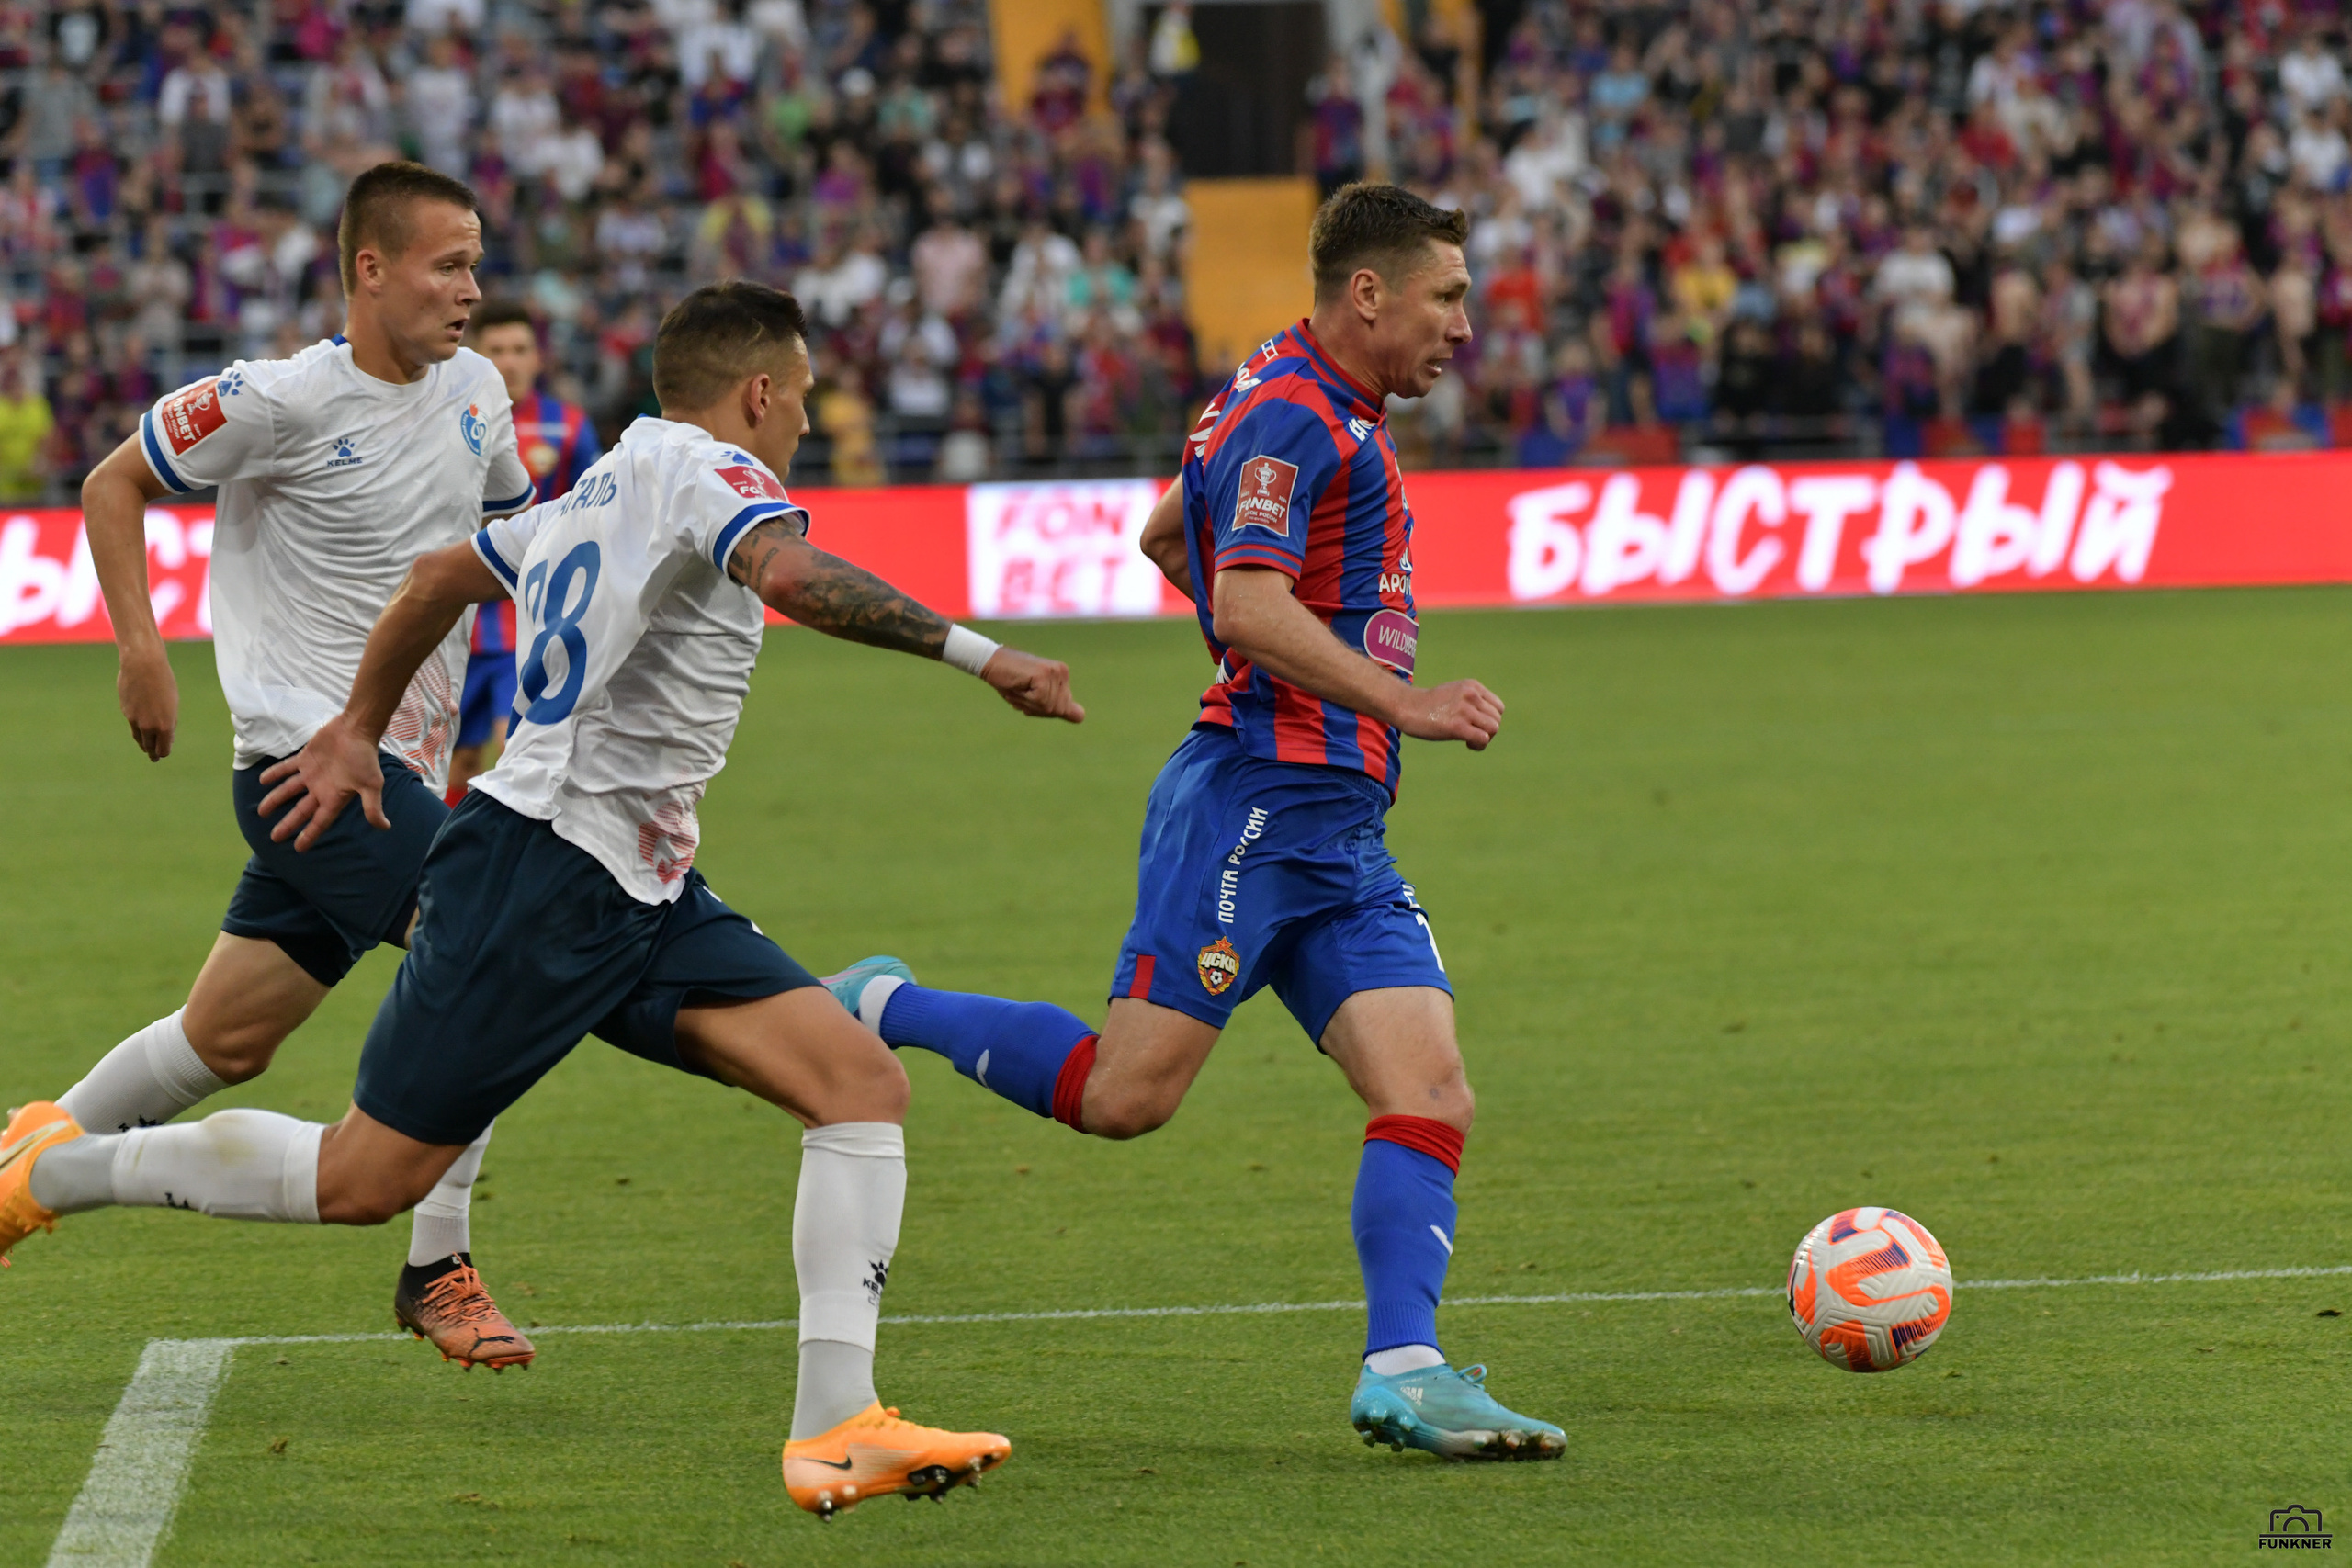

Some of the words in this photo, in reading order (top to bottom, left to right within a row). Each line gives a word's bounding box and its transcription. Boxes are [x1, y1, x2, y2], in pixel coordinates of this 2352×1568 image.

[326, 457, 363, 468] KELME
[1507, 460, 2174, 600] БЫСТРЫЙ
[1227, 807, 1269, 865] РОССИИ
[1217, 869, 1239, 924] ПОЧТА
[1200, 952, 1236, 976] ЦСКА
